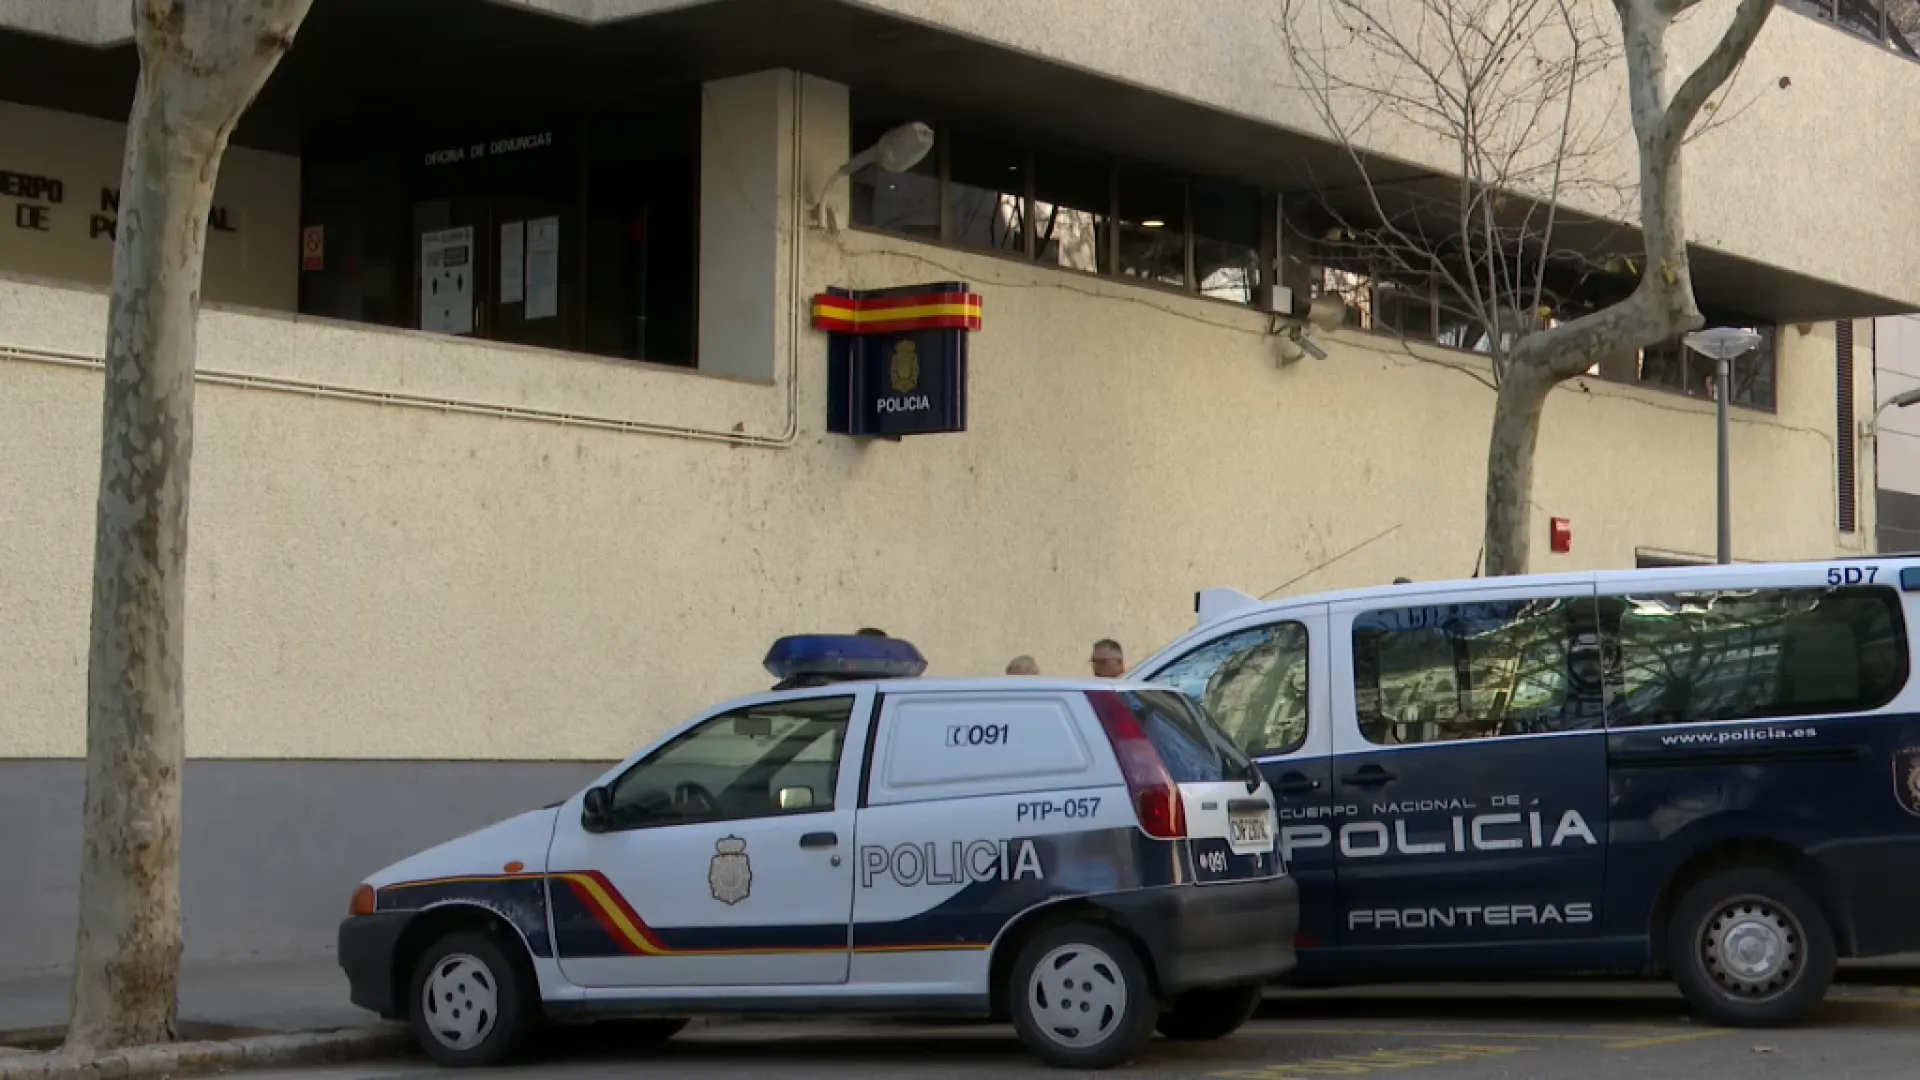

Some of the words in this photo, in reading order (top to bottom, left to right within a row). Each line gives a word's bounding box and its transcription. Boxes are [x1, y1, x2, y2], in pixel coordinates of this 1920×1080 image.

[424, 147, 464, 166] OFICINA
[470, 144, 485, 158] DE
[490, 131, 552, 155] DENUNCIAS
[16, 203, 50, 231] DE
[876, 395, 931, 413] POLICIA
[1827, 566, 1879, 585] 5D7
[968, 723, 1009, 746] 091
[1661, 727, 1817, 745] www.policia.es
[1016, 797, 1102, 822] PTP-057
[1280, 804, 1358, 819] CUERPO
[1373, 799, 1477, 814] NACIONAL
[1492, 795, 1520, 806] DE
[1280, 798, 1597, 861] POLICÍA
[860, 839, 1044, 888] POLICIA
[1348, 903, 1594, 930] FRONTERAS
